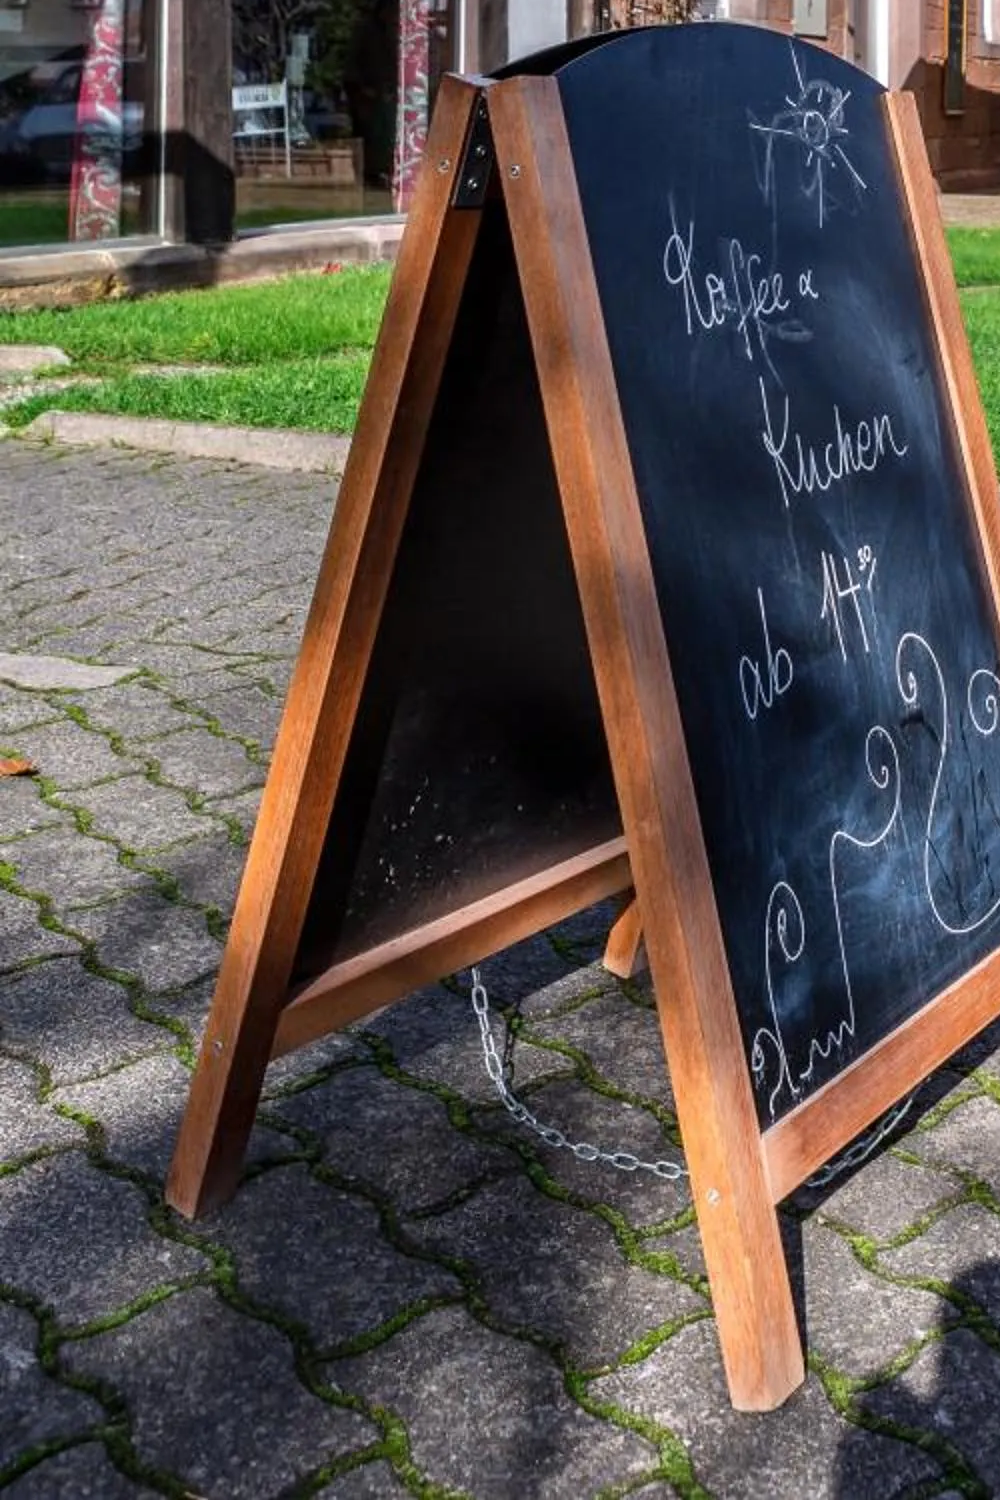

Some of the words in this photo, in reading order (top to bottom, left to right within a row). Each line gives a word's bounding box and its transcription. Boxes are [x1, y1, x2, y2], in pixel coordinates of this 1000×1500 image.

[664, 194, 791, 372] Kaffee
[759, 376, 908, 507] Kuchen
[739, 587, 793, 720] ab
